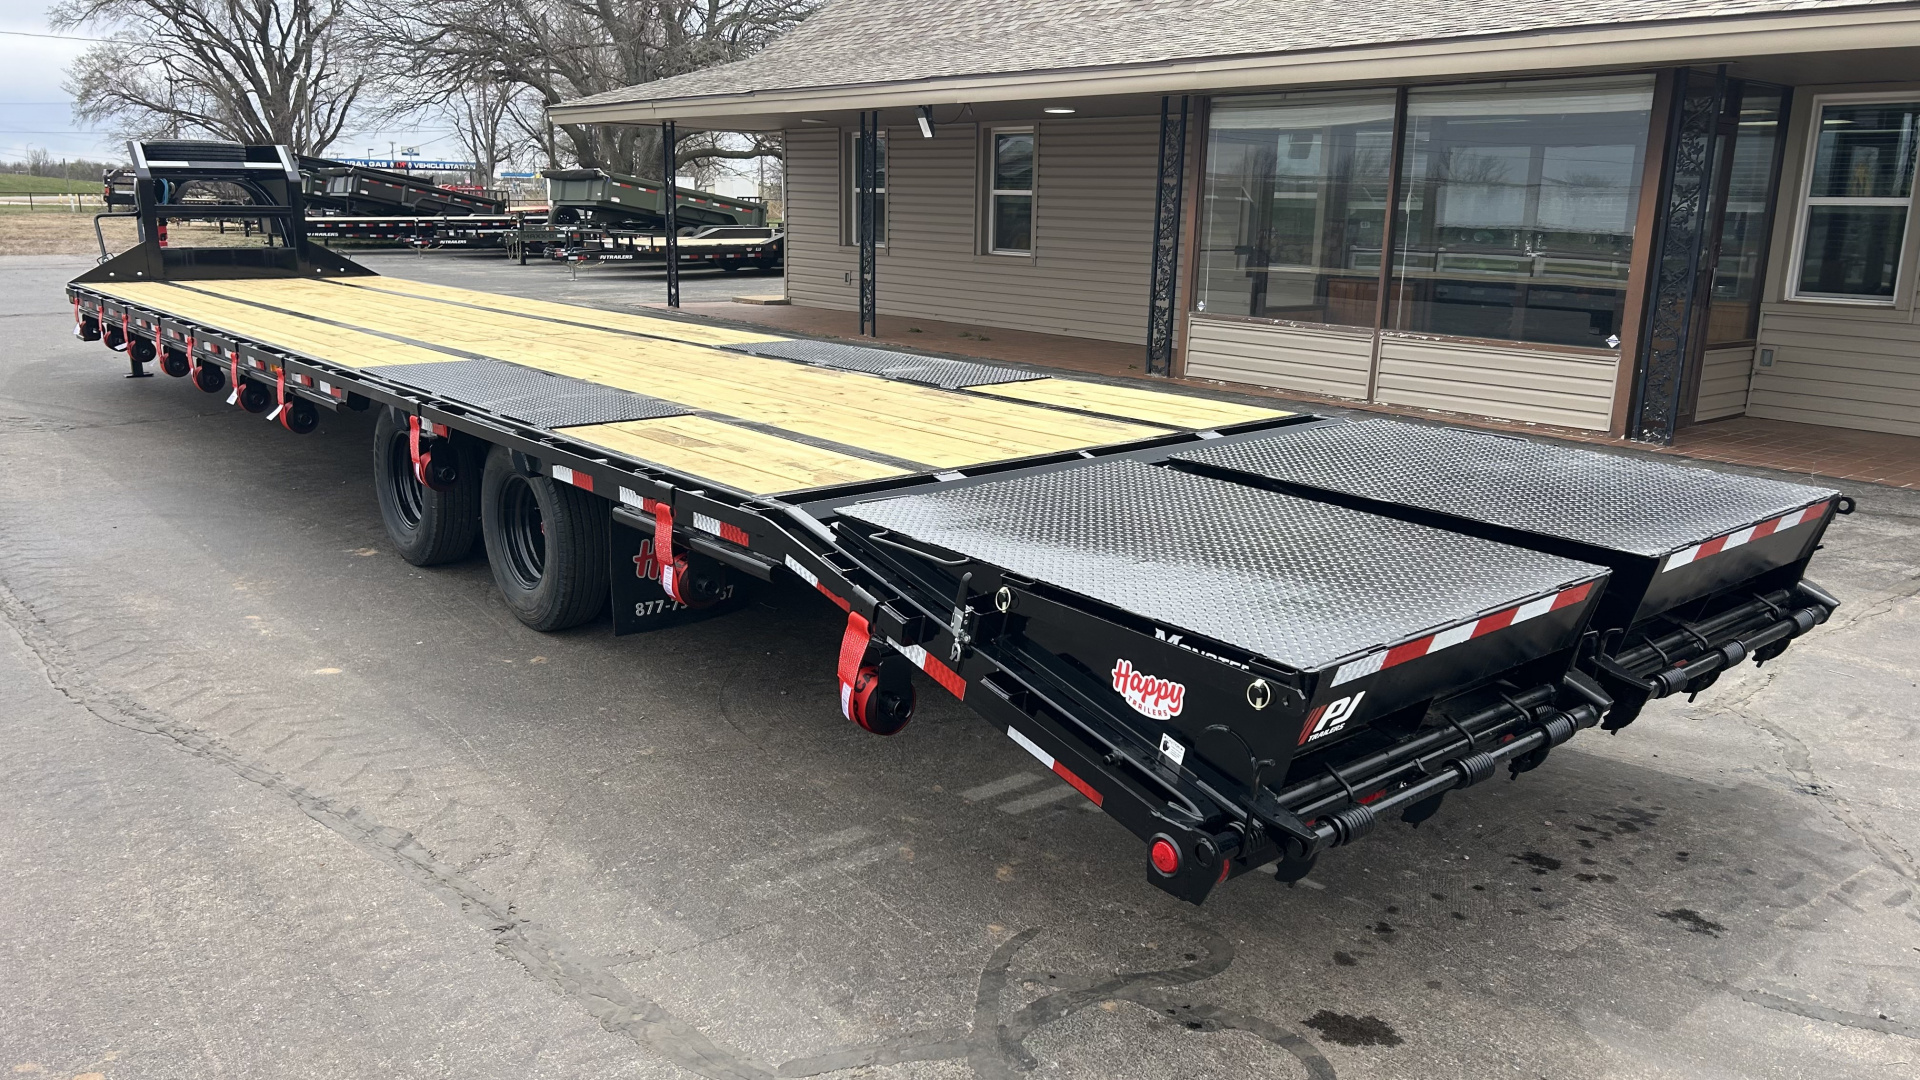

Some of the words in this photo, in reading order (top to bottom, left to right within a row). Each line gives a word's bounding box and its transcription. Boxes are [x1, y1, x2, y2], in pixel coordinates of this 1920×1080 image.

[1112, 659, 1184, 714] Happy
[1128, 694, 1169, 718] TRAILERS
[1312, 690, 1367, 733] PJ
[1307, 722, 1346, 742] TRAILERS
